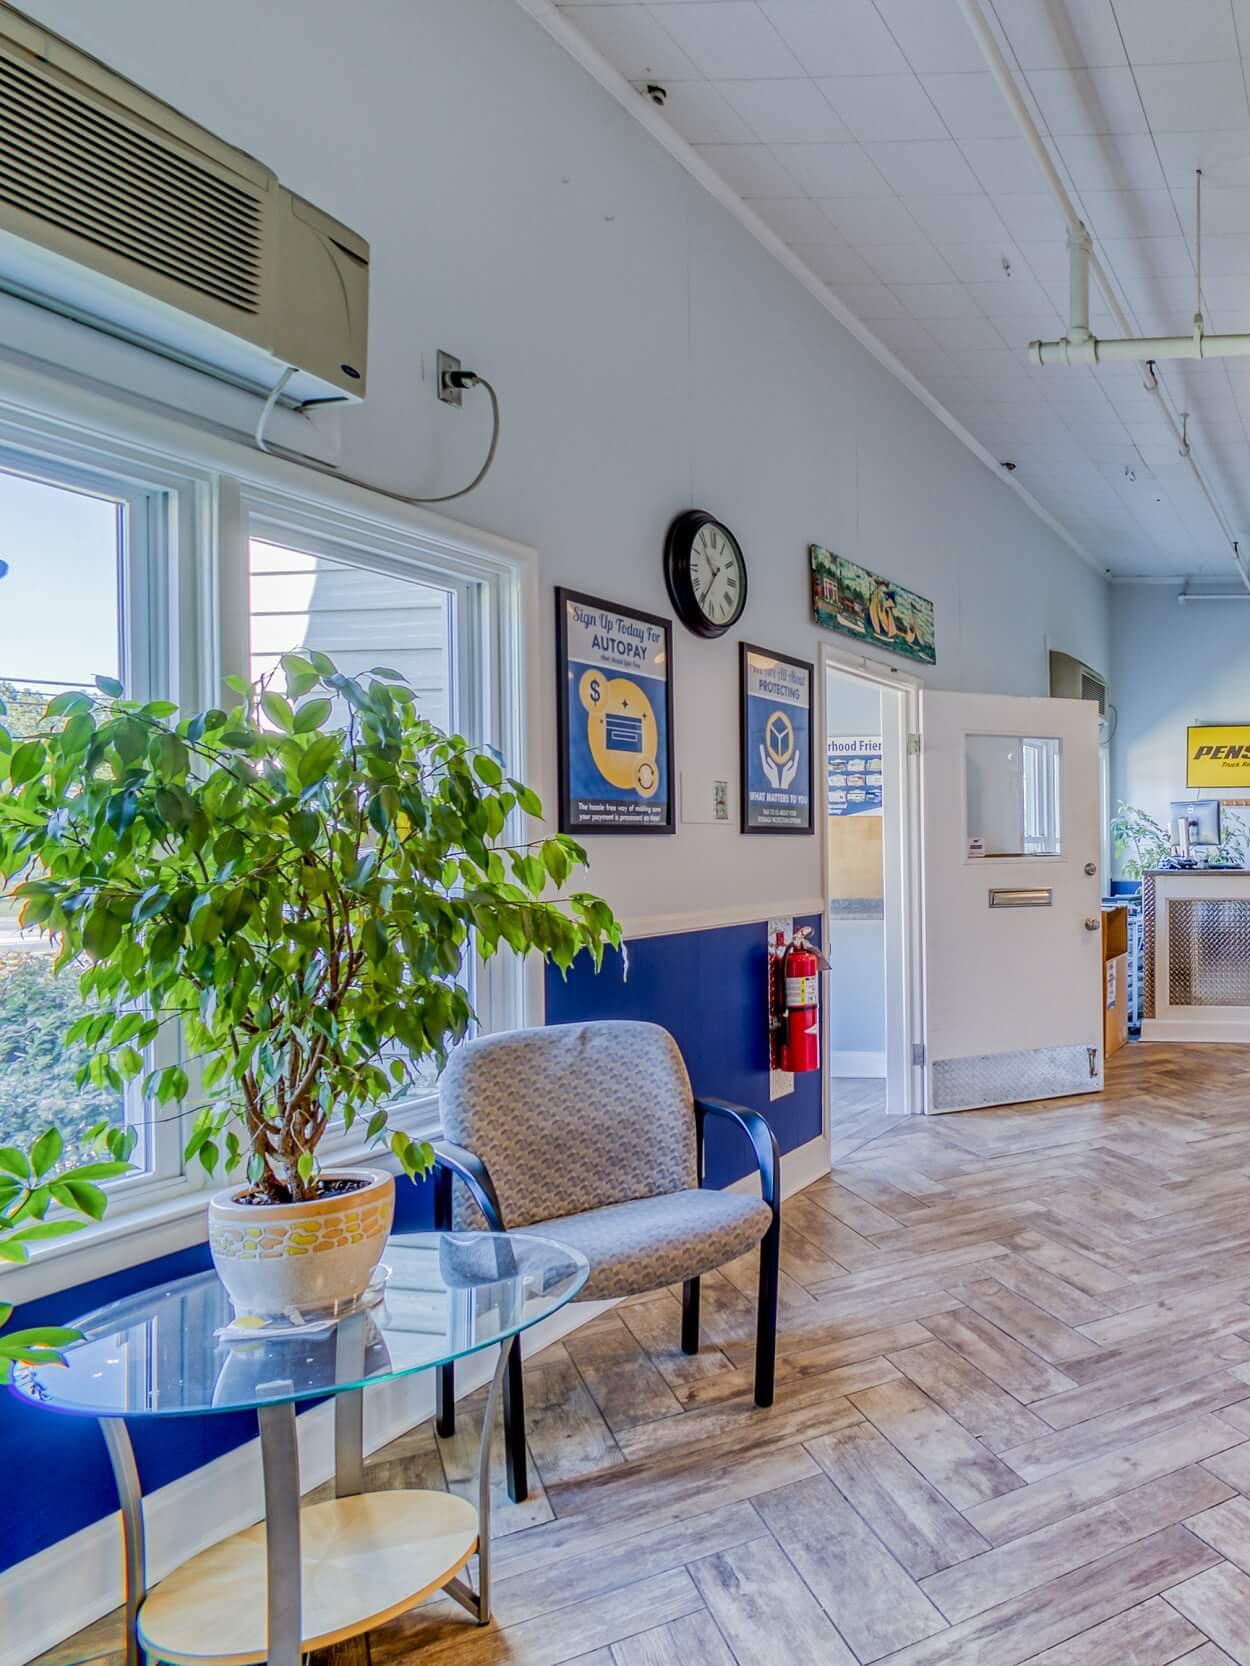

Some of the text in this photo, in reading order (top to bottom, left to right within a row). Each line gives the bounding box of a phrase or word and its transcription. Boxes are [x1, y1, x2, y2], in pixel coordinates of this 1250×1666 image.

[574, 606, 661, 643] Sign Up Today For
[591, 633, 648, 661] AUTOPAY
[758, 679, 801, 701] PROTECTING
[578, 802, 588, 811] The
[749, 791, 767, 802] WHAT
[767, 792, 790, 803] MATTERS
[790, 793, 797, 804] TO
